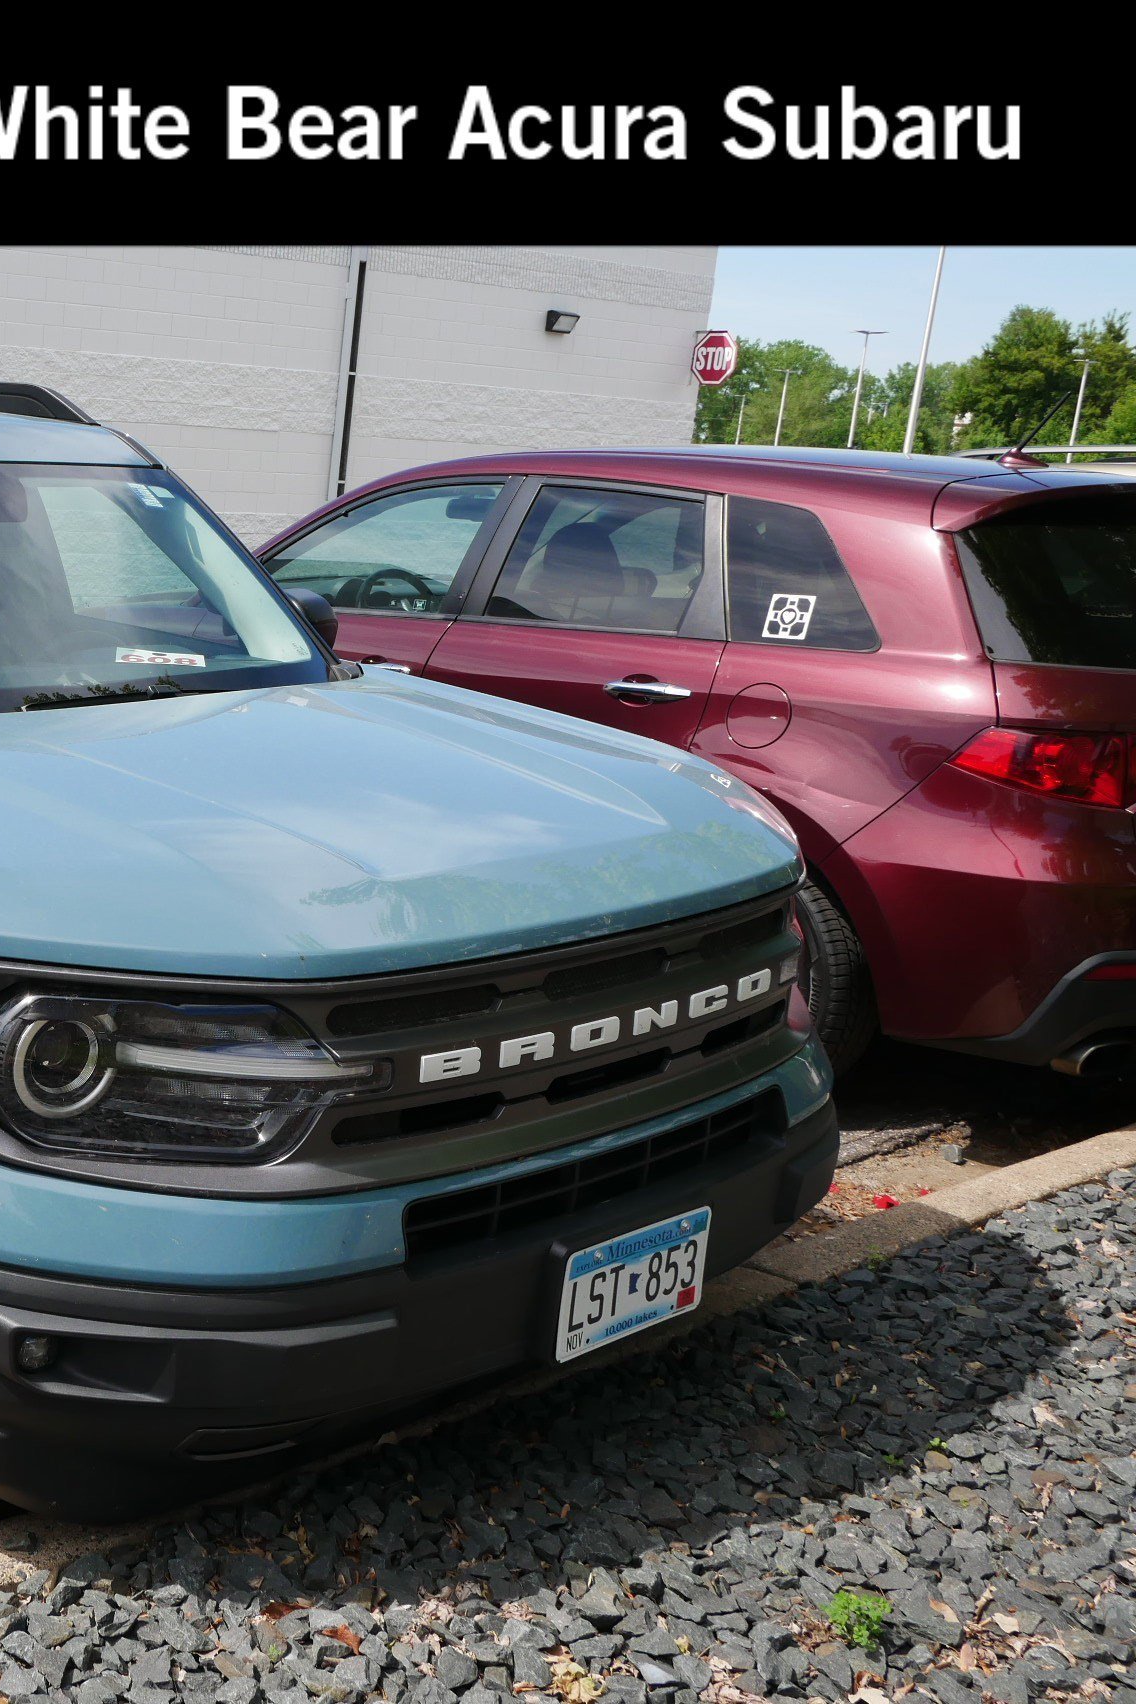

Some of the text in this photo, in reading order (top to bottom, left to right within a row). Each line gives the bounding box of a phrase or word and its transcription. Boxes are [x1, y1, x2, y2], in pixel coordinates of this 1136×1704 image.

[696, 346, 733, 371] STOP
[419, 968, 771, 1084] BRONCO
[567, 1239, 698, 1333] LST 853
[604, 1310, 658, 1337] 10,000 lakes
[566, 1331, 584, 1353] NOV
